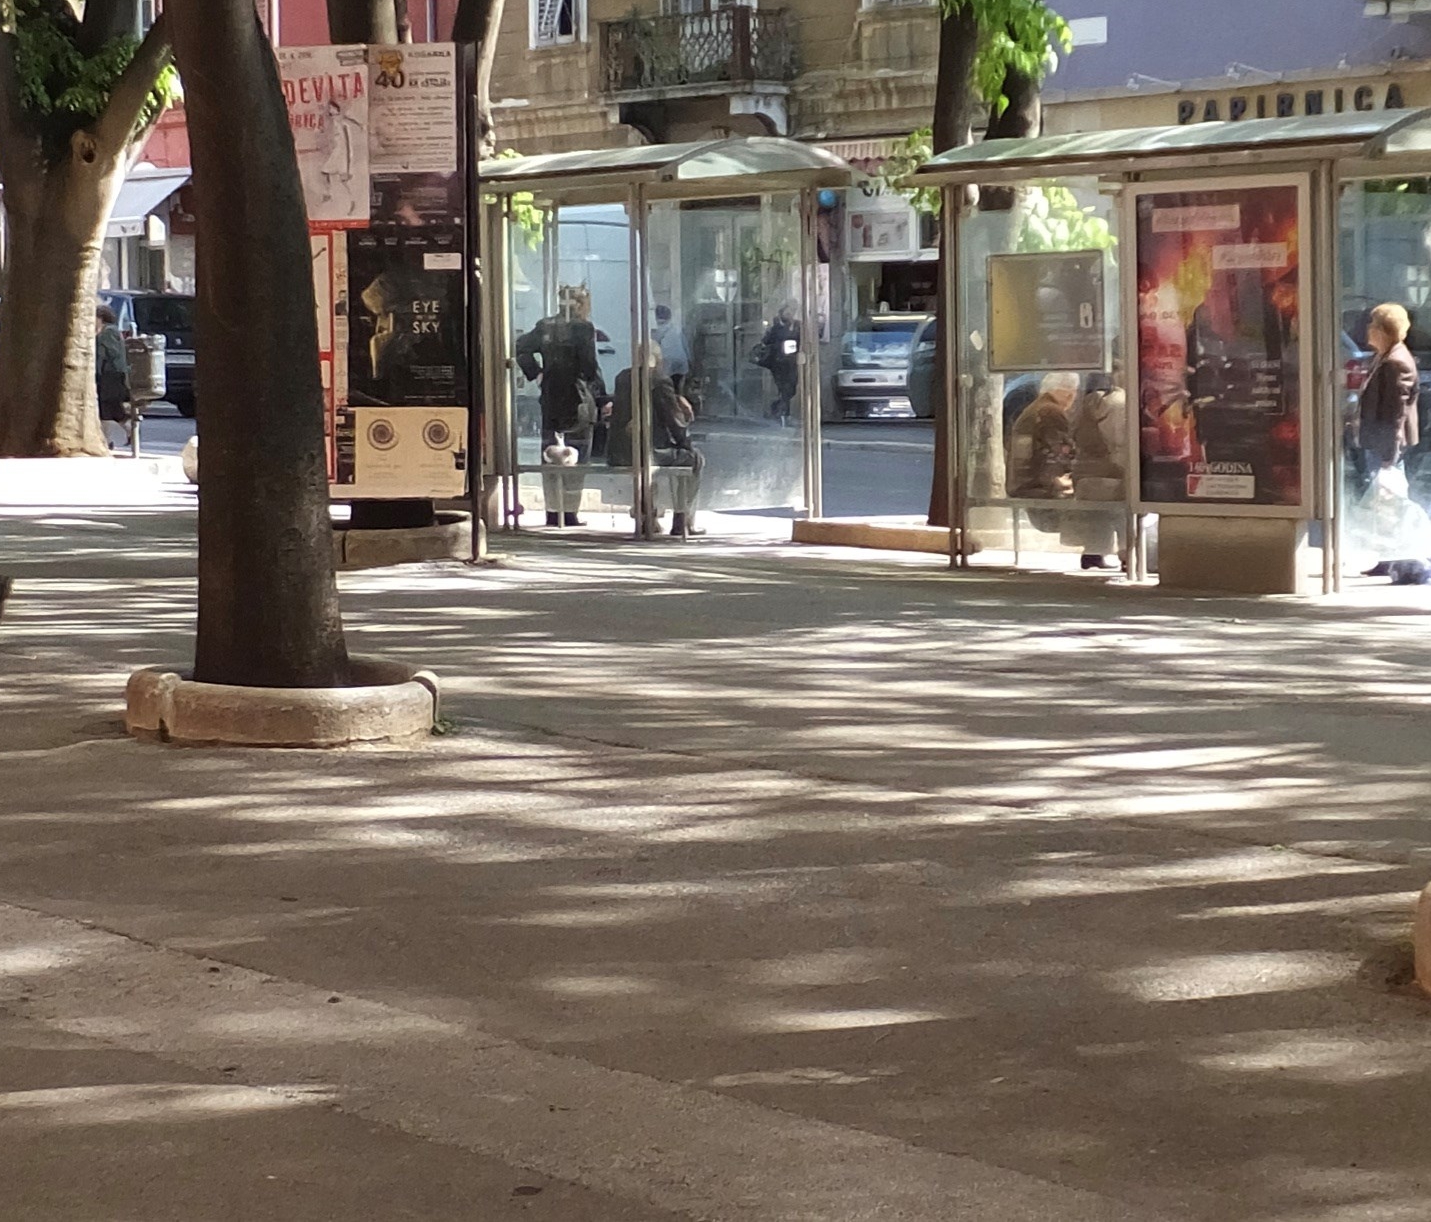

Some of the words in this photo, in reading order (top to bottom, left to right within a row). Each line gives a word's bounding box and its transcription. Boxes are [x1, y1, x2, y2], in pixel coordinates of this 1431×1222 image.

[375, 70, 405, 89] 40
[1177, 83, 1405, 125] PAPIRNICA
[412, 300, 441, 314] EYE
[412, 321, 441, 335] SKY
